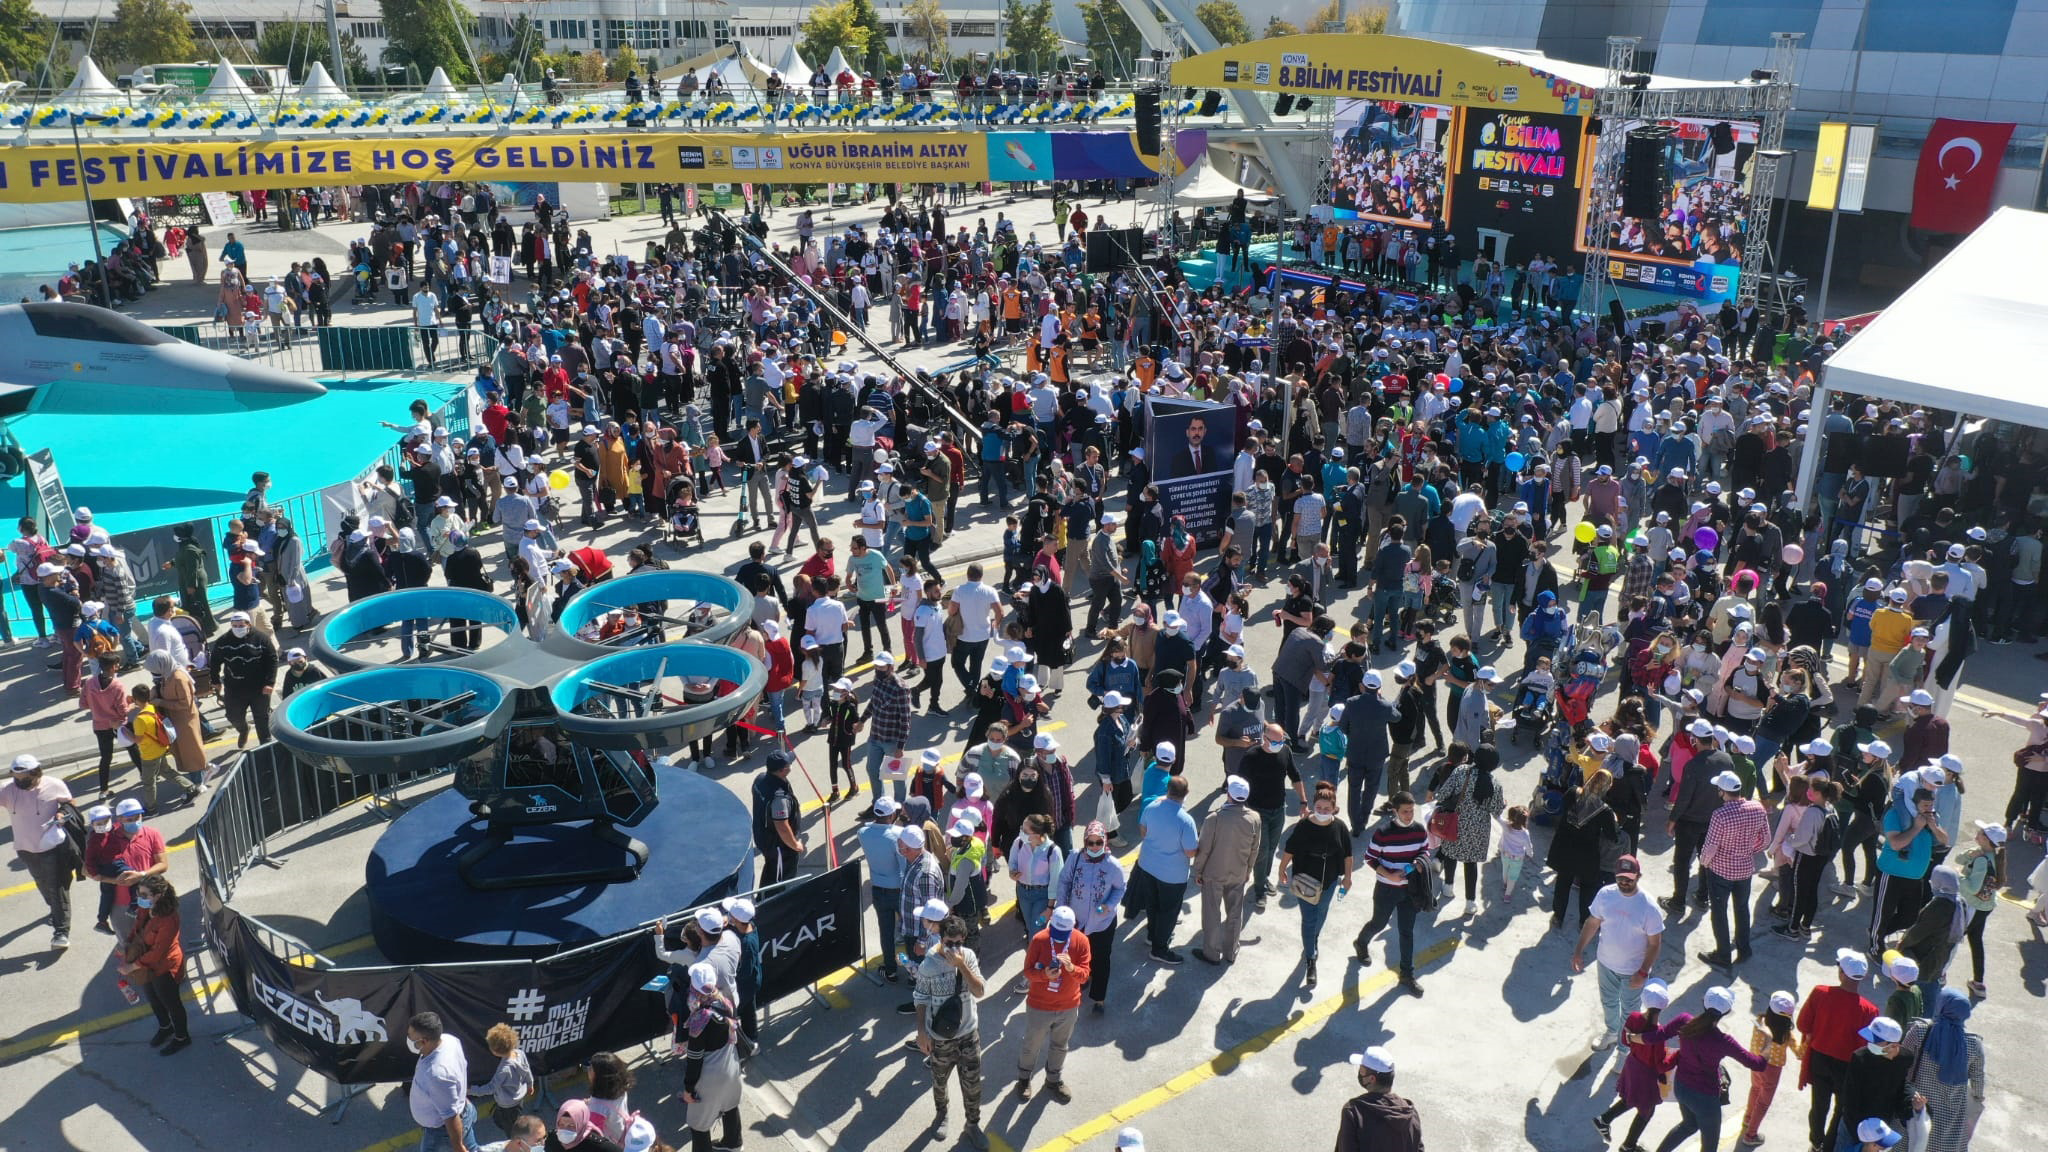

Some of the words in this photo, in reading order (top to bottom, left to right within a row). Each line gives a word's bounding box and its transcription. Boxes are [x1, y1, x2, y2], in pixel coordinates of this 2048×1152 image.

[1282, 54, 1306, 65] KONYA
[1347, 66, 1443, 98] FESTİVALİ
[30, 145, 352, 188] FESTİVALİMİZE
[372, 148, 455, 175] HOŞ
[474, 139, 656, 169] GELDİNİZ
[788, 142, 837, 159] UĞUR
[842, 141, 914, 158] İBRAHİM
[919, 144, 968, 158] ALTAY
[790, 162, 822, 170] KONYA
[825, 160, 882, 171] BÜYÜKŞEHİR
[886, 160, 928, 169] BELEDİYE
[931, 161, 970, 171] BAŞKANI
[758, 912, 837, 964] YKAR
[512, 1012, 587, 1040] EKNOLOJİ
